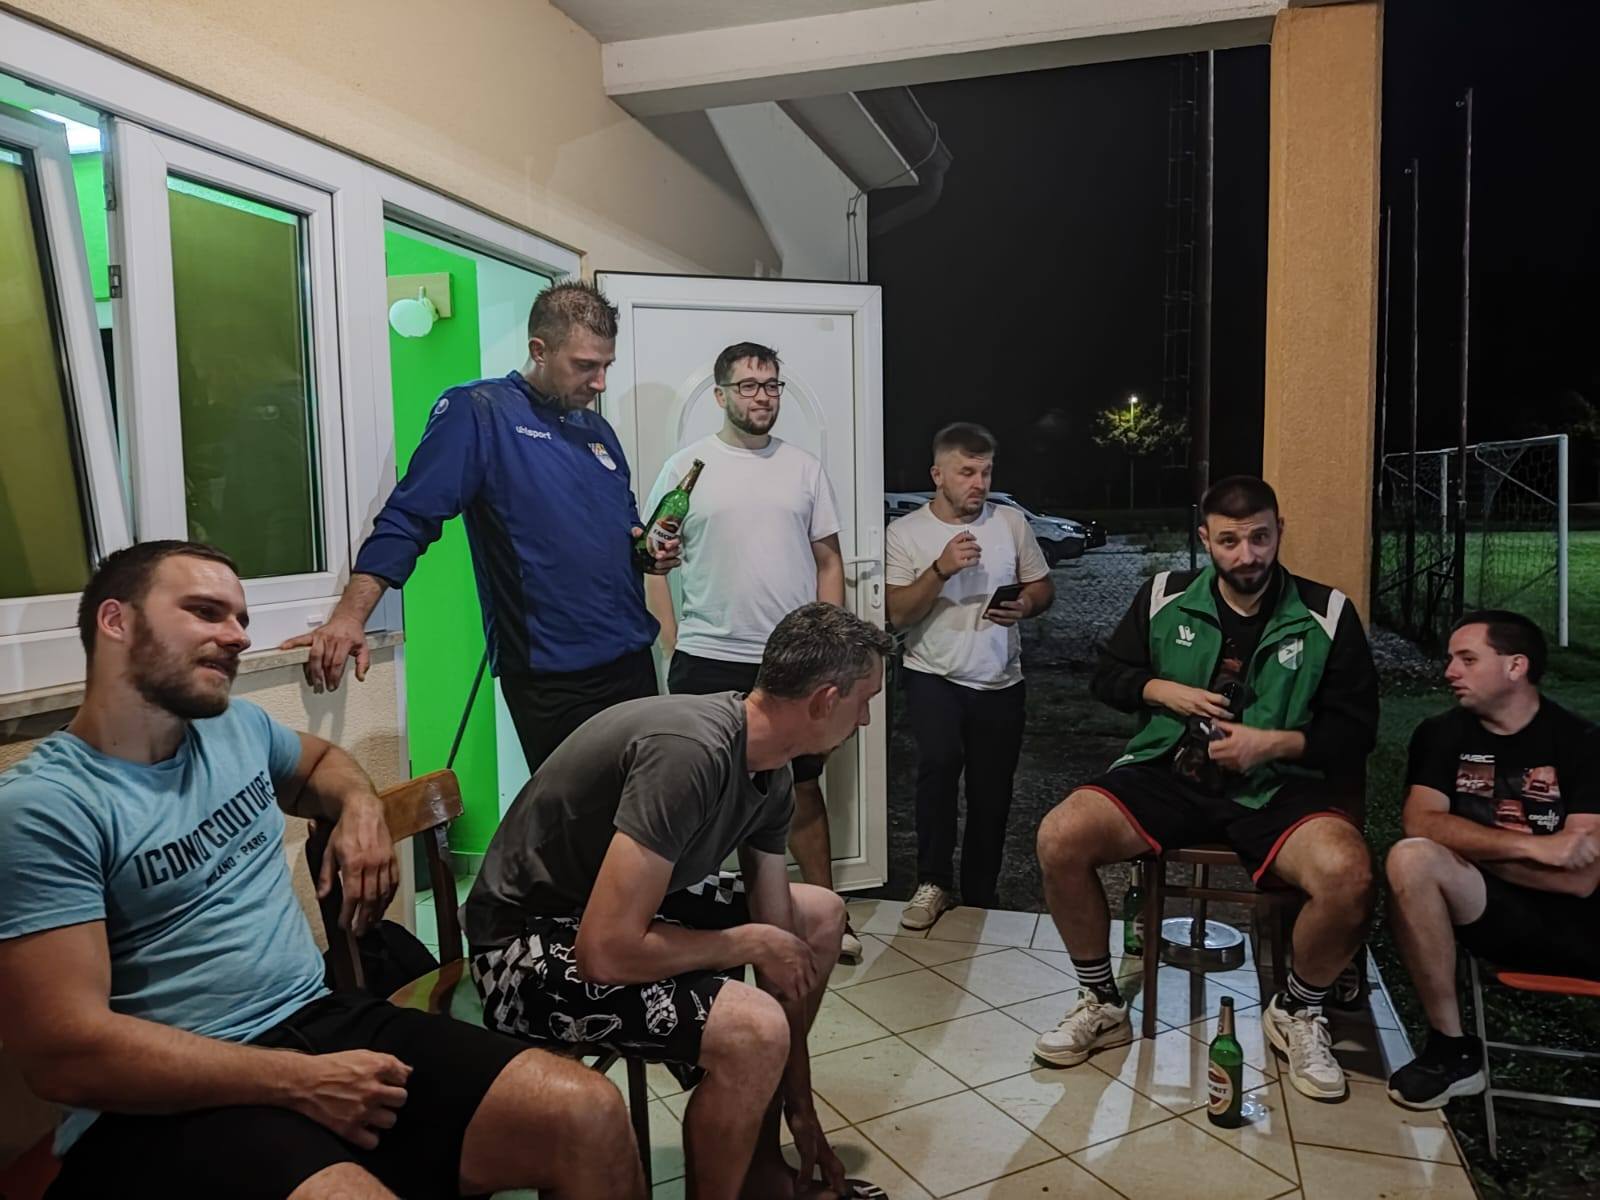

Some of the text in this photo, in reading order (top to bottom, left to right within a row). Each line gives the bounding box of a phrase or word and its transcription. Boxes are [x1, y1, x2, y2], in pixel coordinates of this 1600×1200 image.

[515, 425, 552, 440] uhlsport
[206, 856, 237, 887] LANO
[240, 832, 267, 855] PARIS
